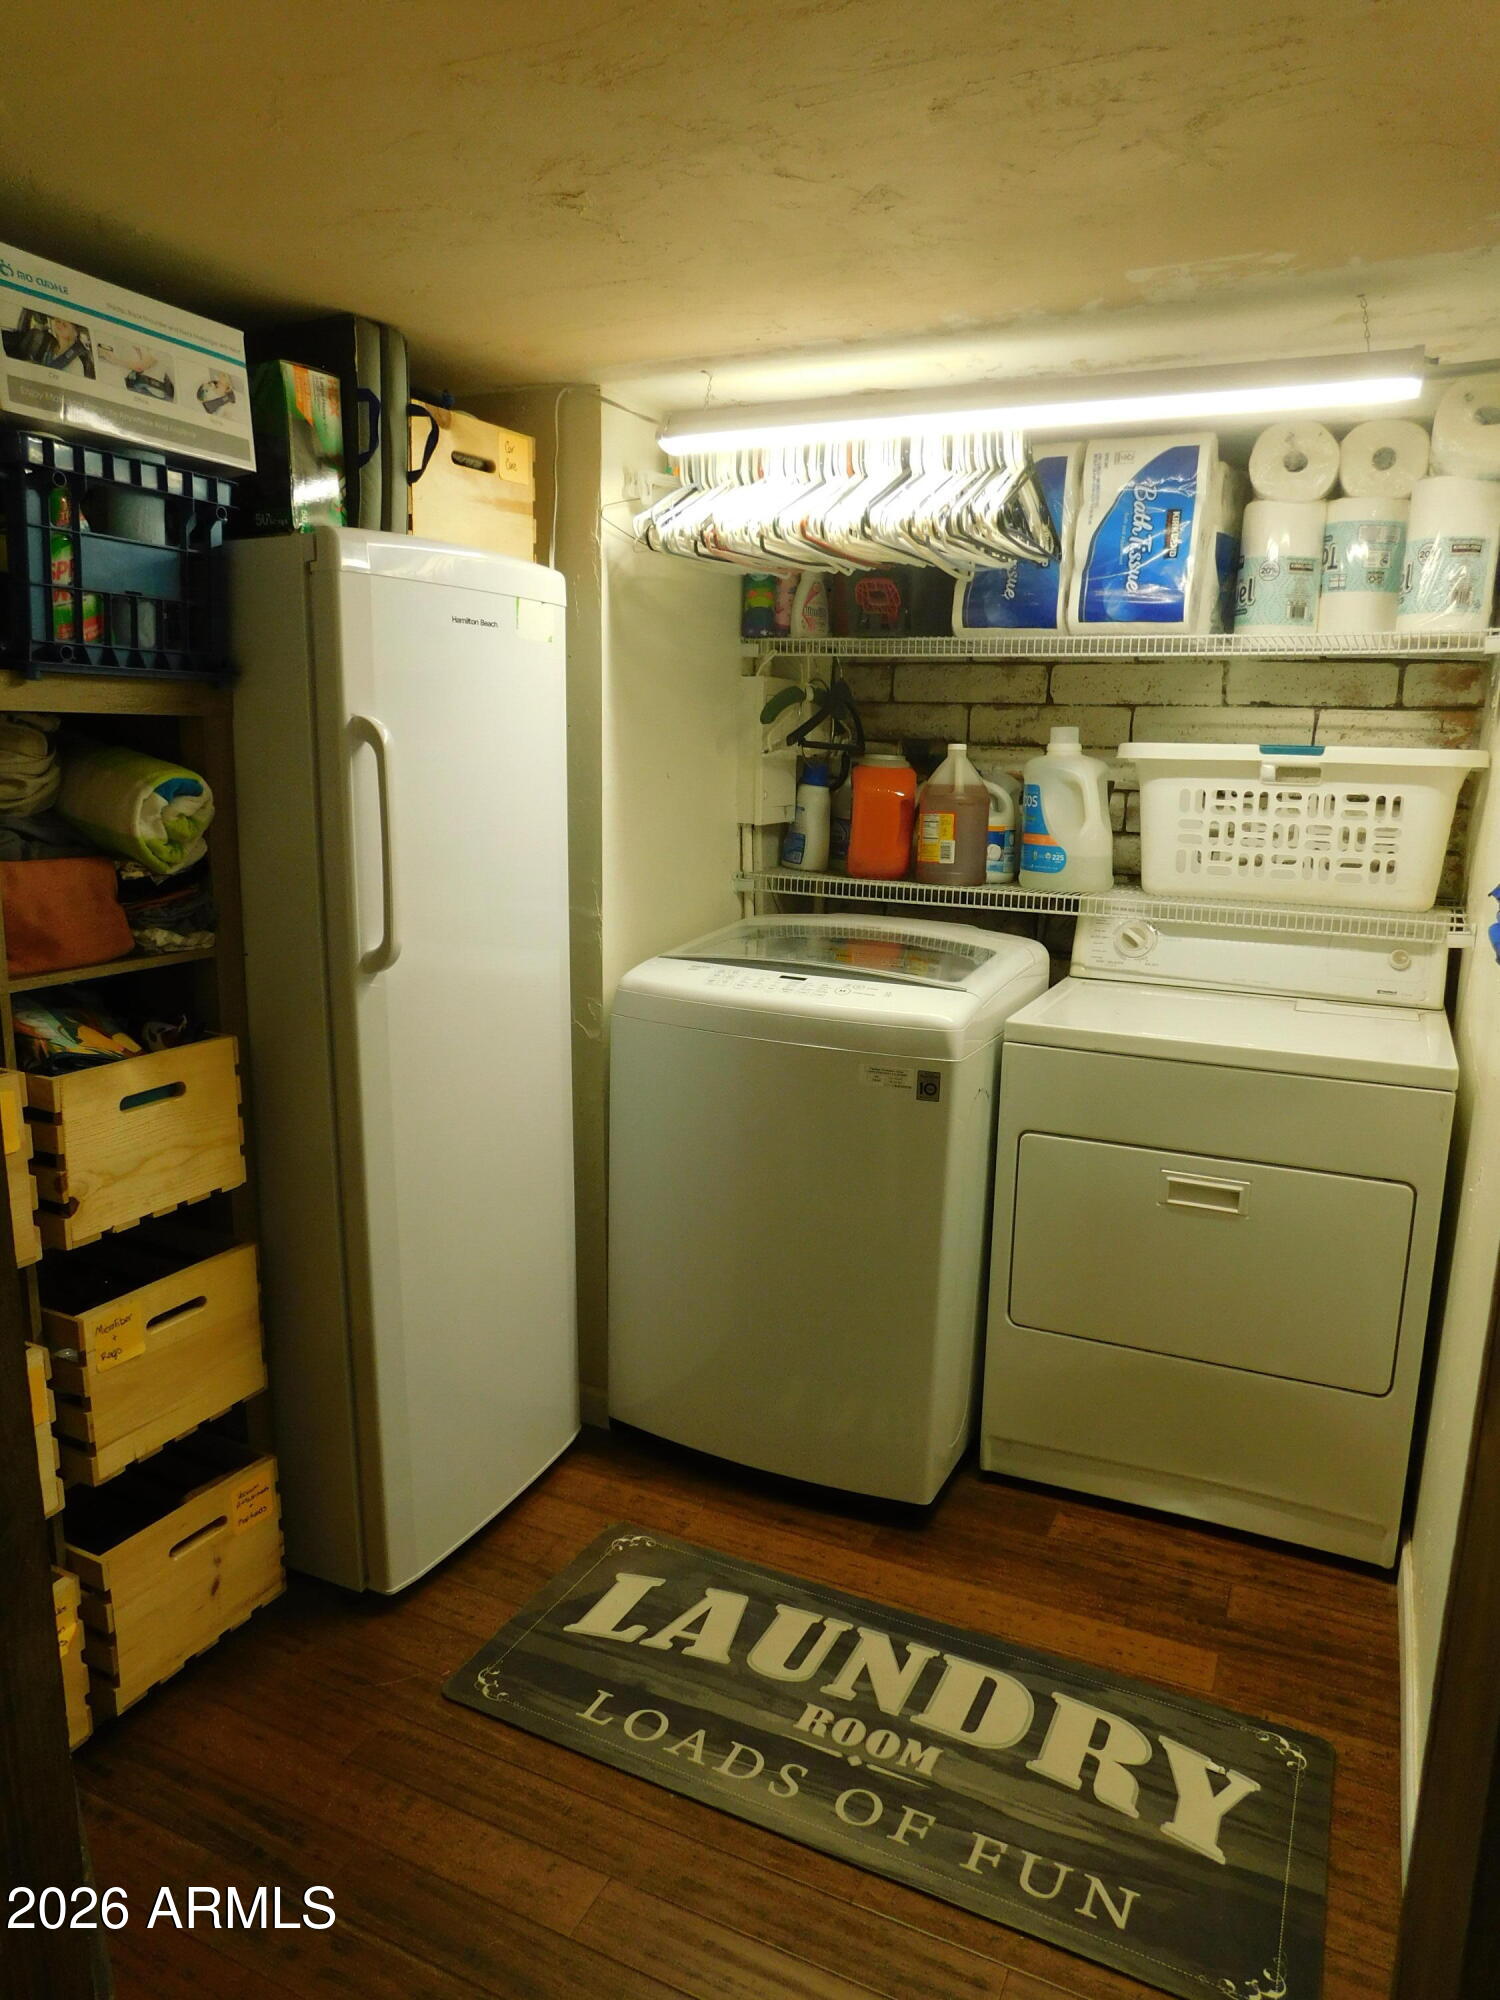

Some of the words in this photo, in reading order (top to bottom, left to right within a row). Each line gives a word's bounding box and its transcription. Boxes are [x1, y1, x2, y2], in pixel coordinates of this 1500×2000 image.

[1132, 485, 1158, 536] Bath
[1125, 534, 1154, 593] Tissue
[451, 615, 479, 626] Hamilton
[480, 618, 499, 628] Beach
[563, 1572, 1262, 1866] LAUNDRY
[793, 1702, 944, 1777] ROOM
[576, 1689, 809, 1799] LOADS
[834, 1788, 937, 1847] OF
[959, 1831, 1141, 1930] FUN
